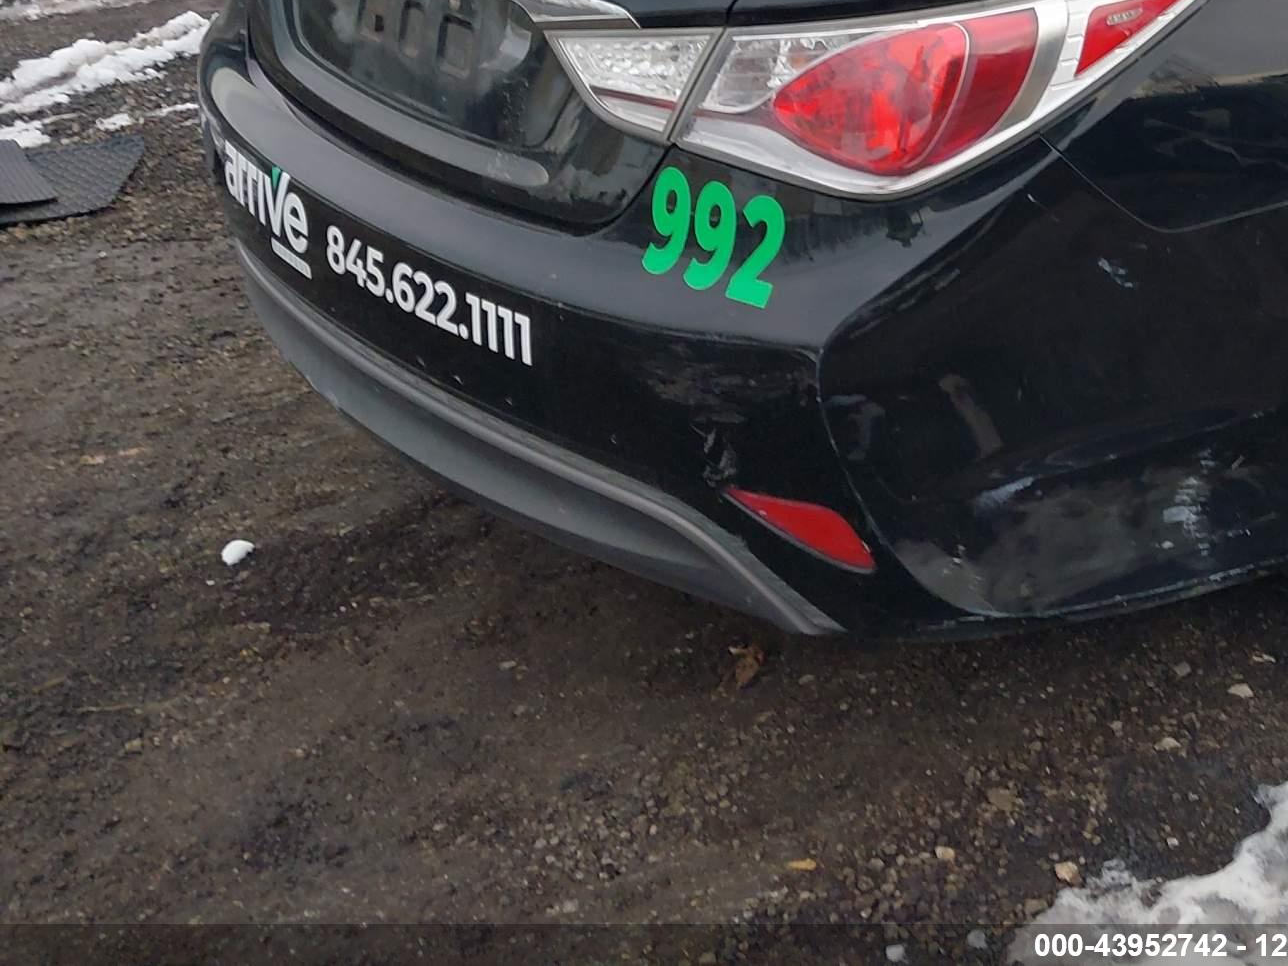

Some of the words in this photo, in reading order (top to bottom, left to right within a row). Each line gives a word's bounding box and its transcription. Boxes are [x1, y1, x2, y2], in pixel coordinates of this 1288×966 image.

[224, 139, 309, 254] arrive
[641, 166, 786, 309] 992
[326, 224, 533, 367] 845.622.1111
